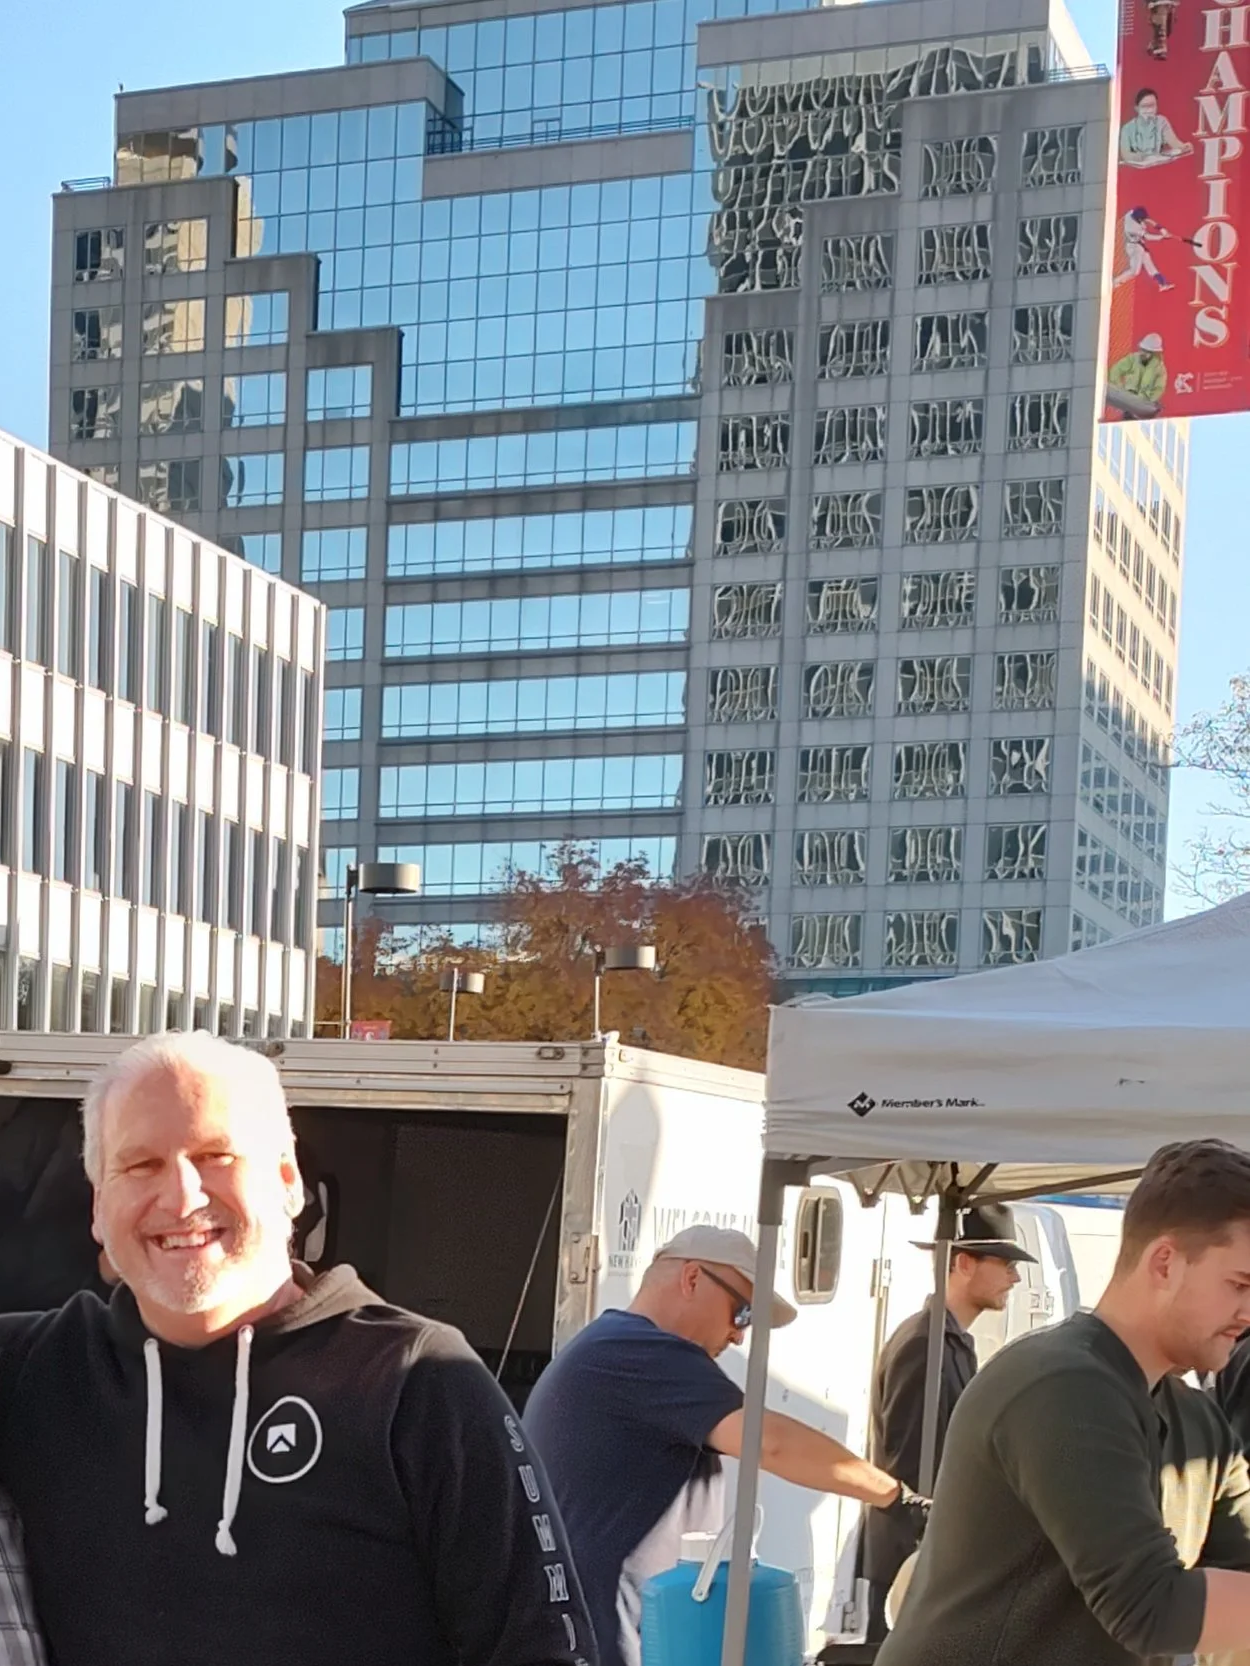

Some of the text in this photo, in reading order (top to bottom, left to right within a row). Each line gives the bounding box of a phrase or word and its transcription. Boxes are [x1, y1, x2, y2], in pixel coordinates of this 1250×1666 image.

[1188, 0, 1250, 348] HAMPIONS
[881, 1097, 978, 1108] Member's Mark
